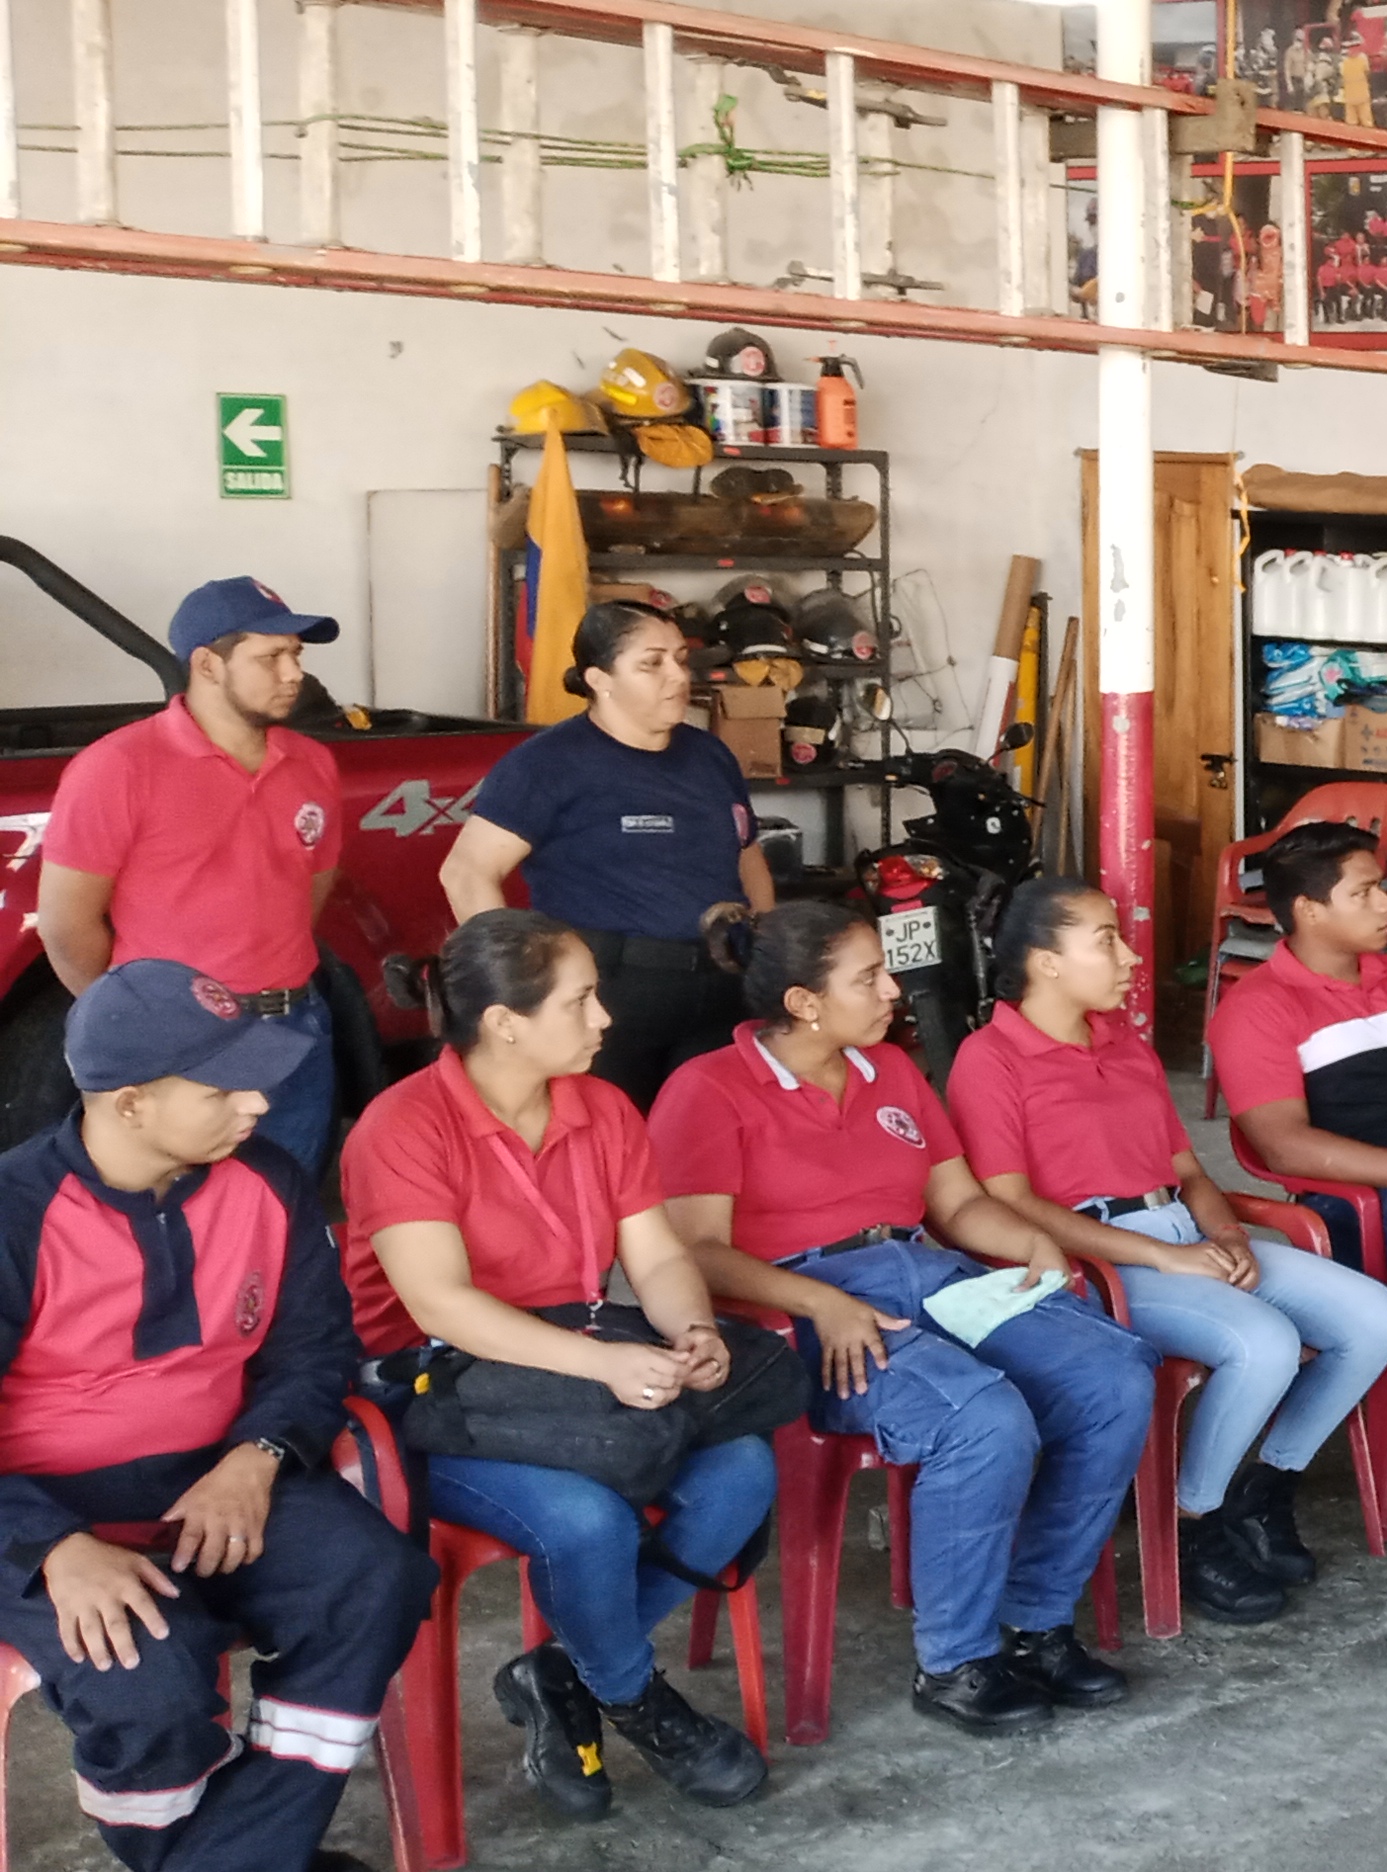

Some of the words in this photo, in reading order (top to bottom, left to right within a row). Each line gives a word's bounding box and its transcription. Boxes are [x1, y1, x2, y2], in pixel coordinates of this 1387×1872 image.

[224, 471, 283, 489] SALIDA
[896, 920, 921, 942] JP
[887, 940, 936, 967] 152X
